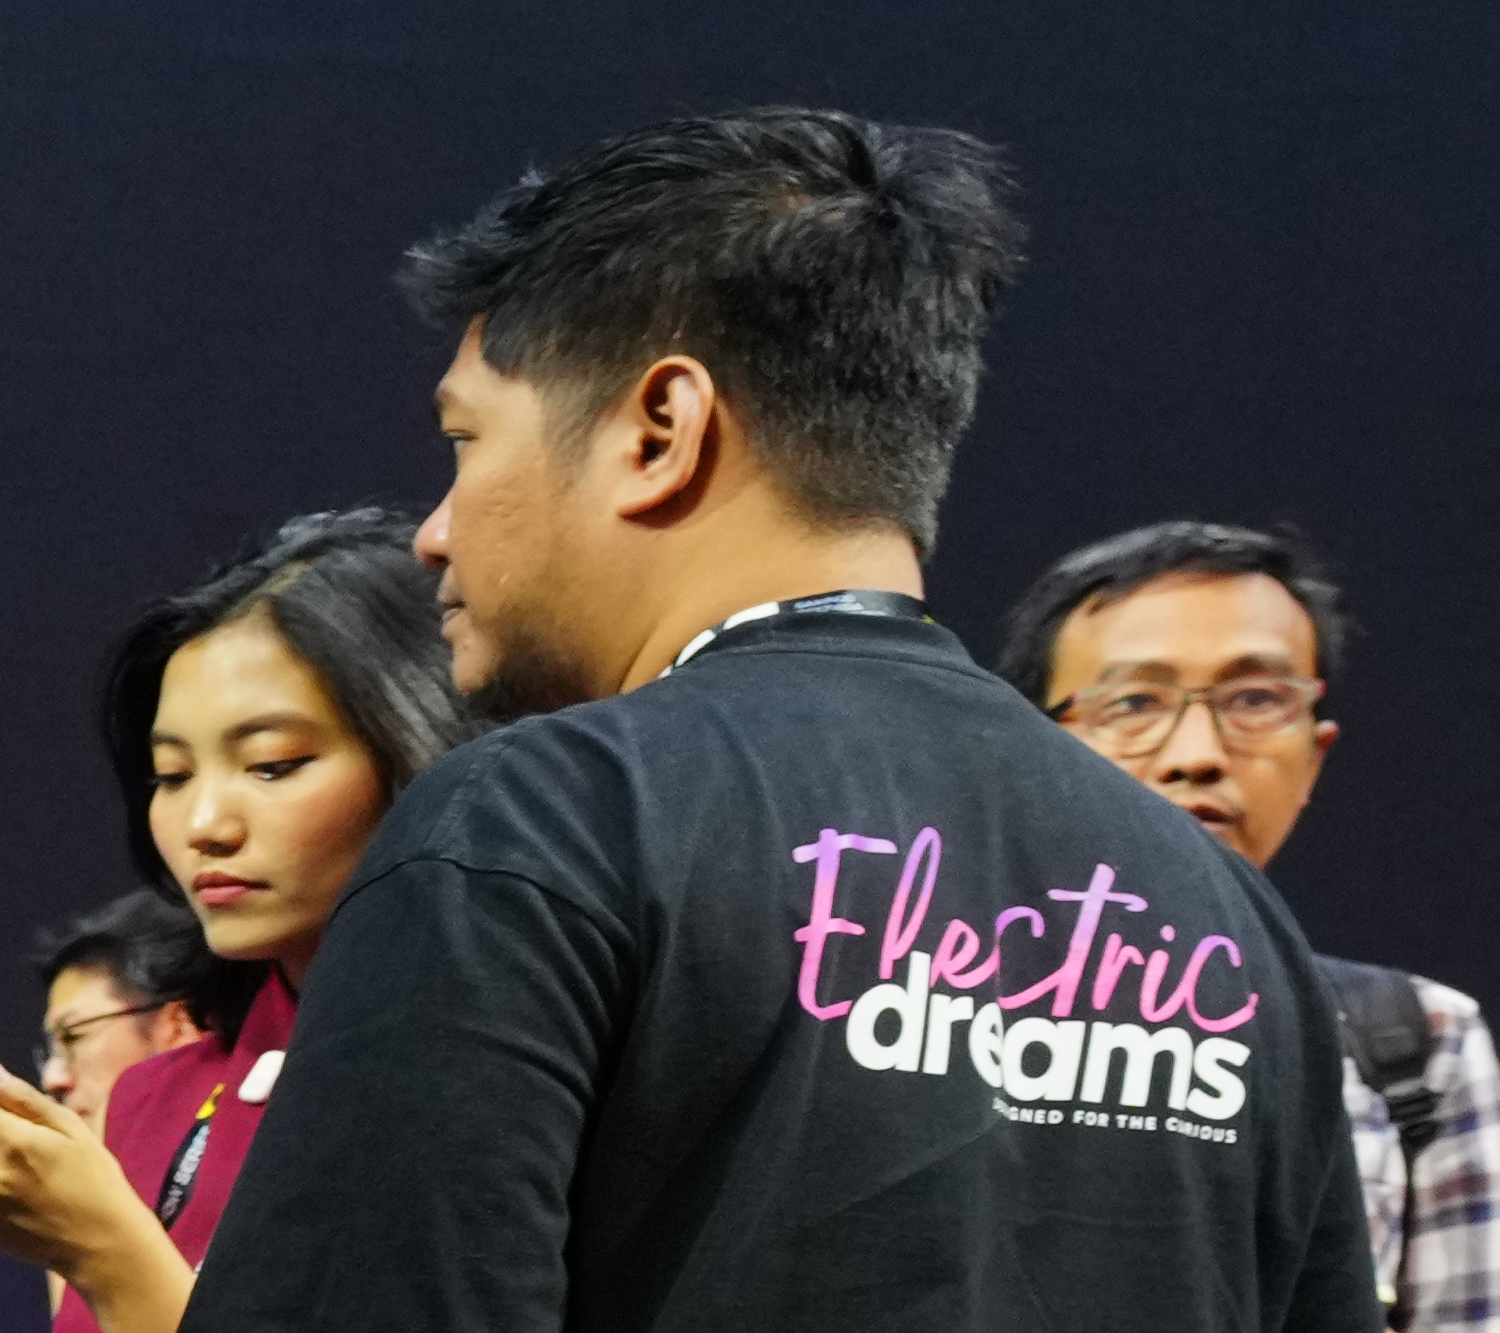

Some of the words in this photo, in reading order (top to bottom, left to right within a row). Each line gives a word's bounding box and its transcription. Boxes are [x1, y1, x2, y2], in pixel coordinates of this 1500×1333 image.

[791, 826, 1259, 1033] Electric
[846, 951, 1252, 1121] dreams
[1072, 1109, 1110, 1128] FOR
[1115, 1113, 1158, 1131] THE
